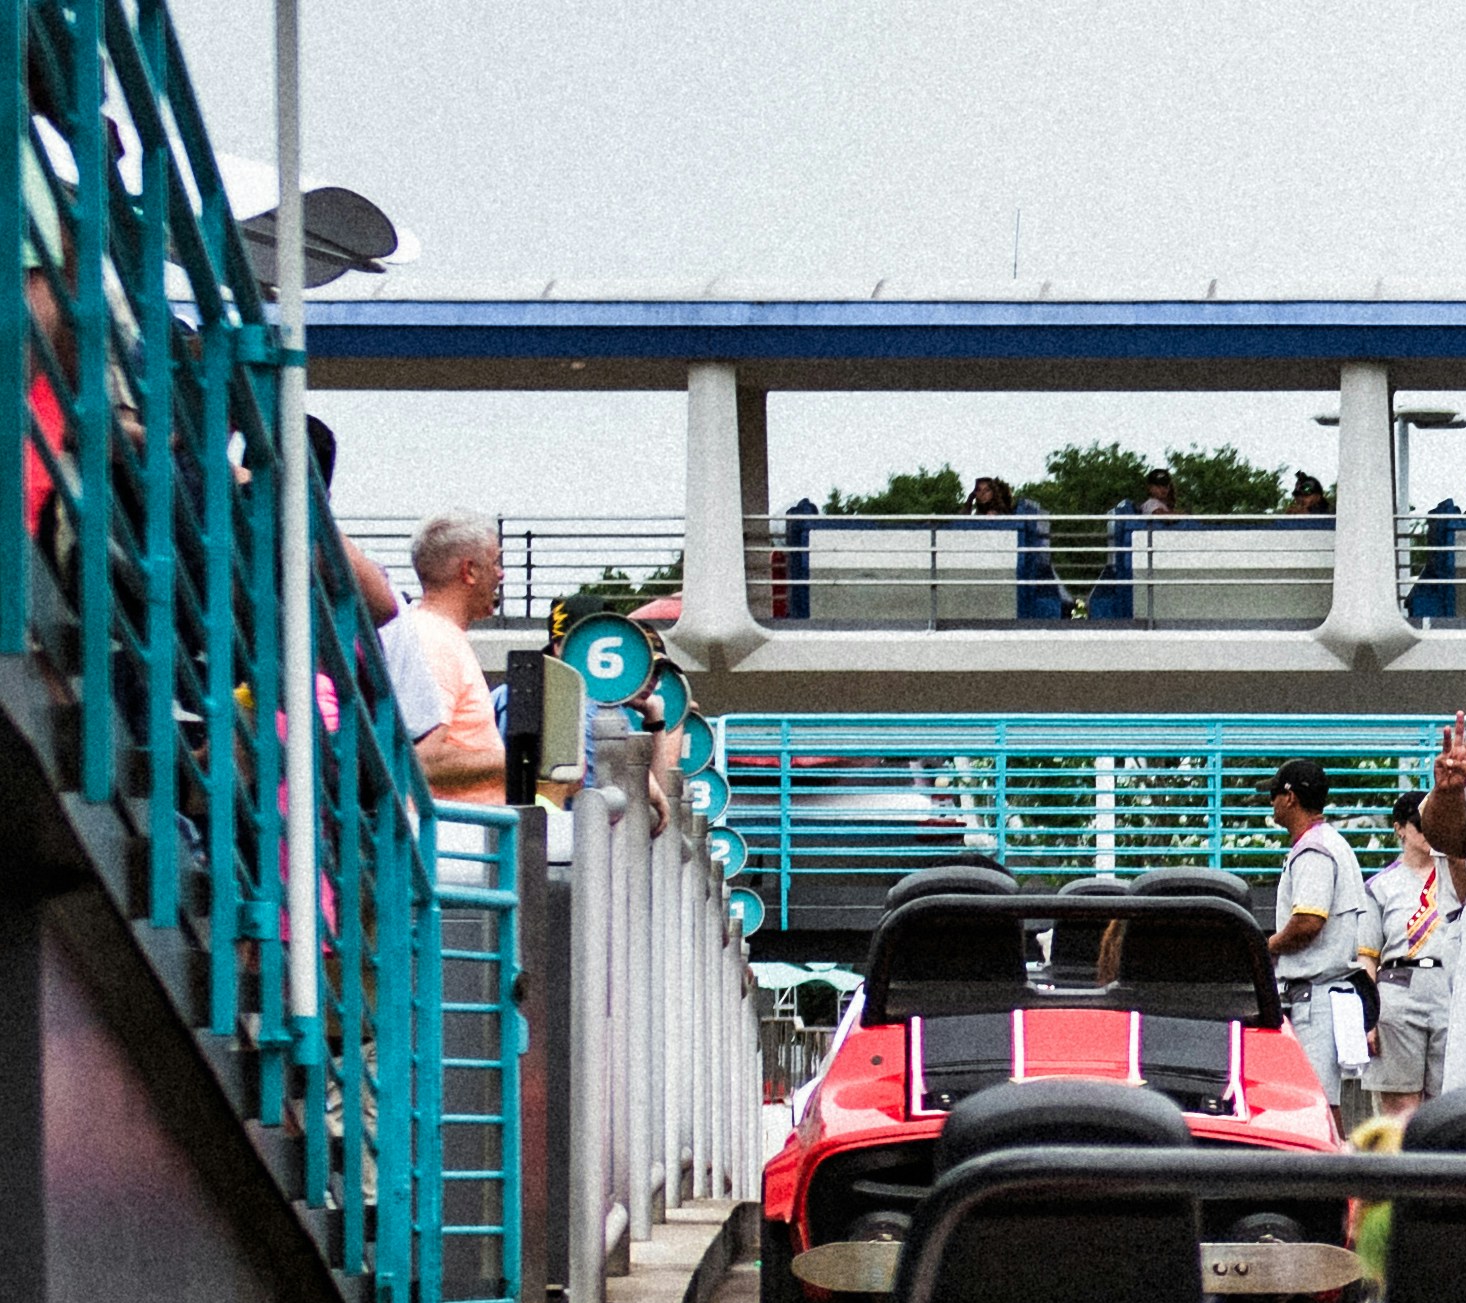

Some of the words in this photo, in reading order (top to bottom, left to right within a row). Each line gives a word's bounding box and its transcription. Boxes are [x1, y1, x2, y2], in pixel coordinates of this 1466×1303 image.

[586, 636, 624, 679] 6
[689, 780, 711, 809] 3
[710, 839, 731, 862] 2
